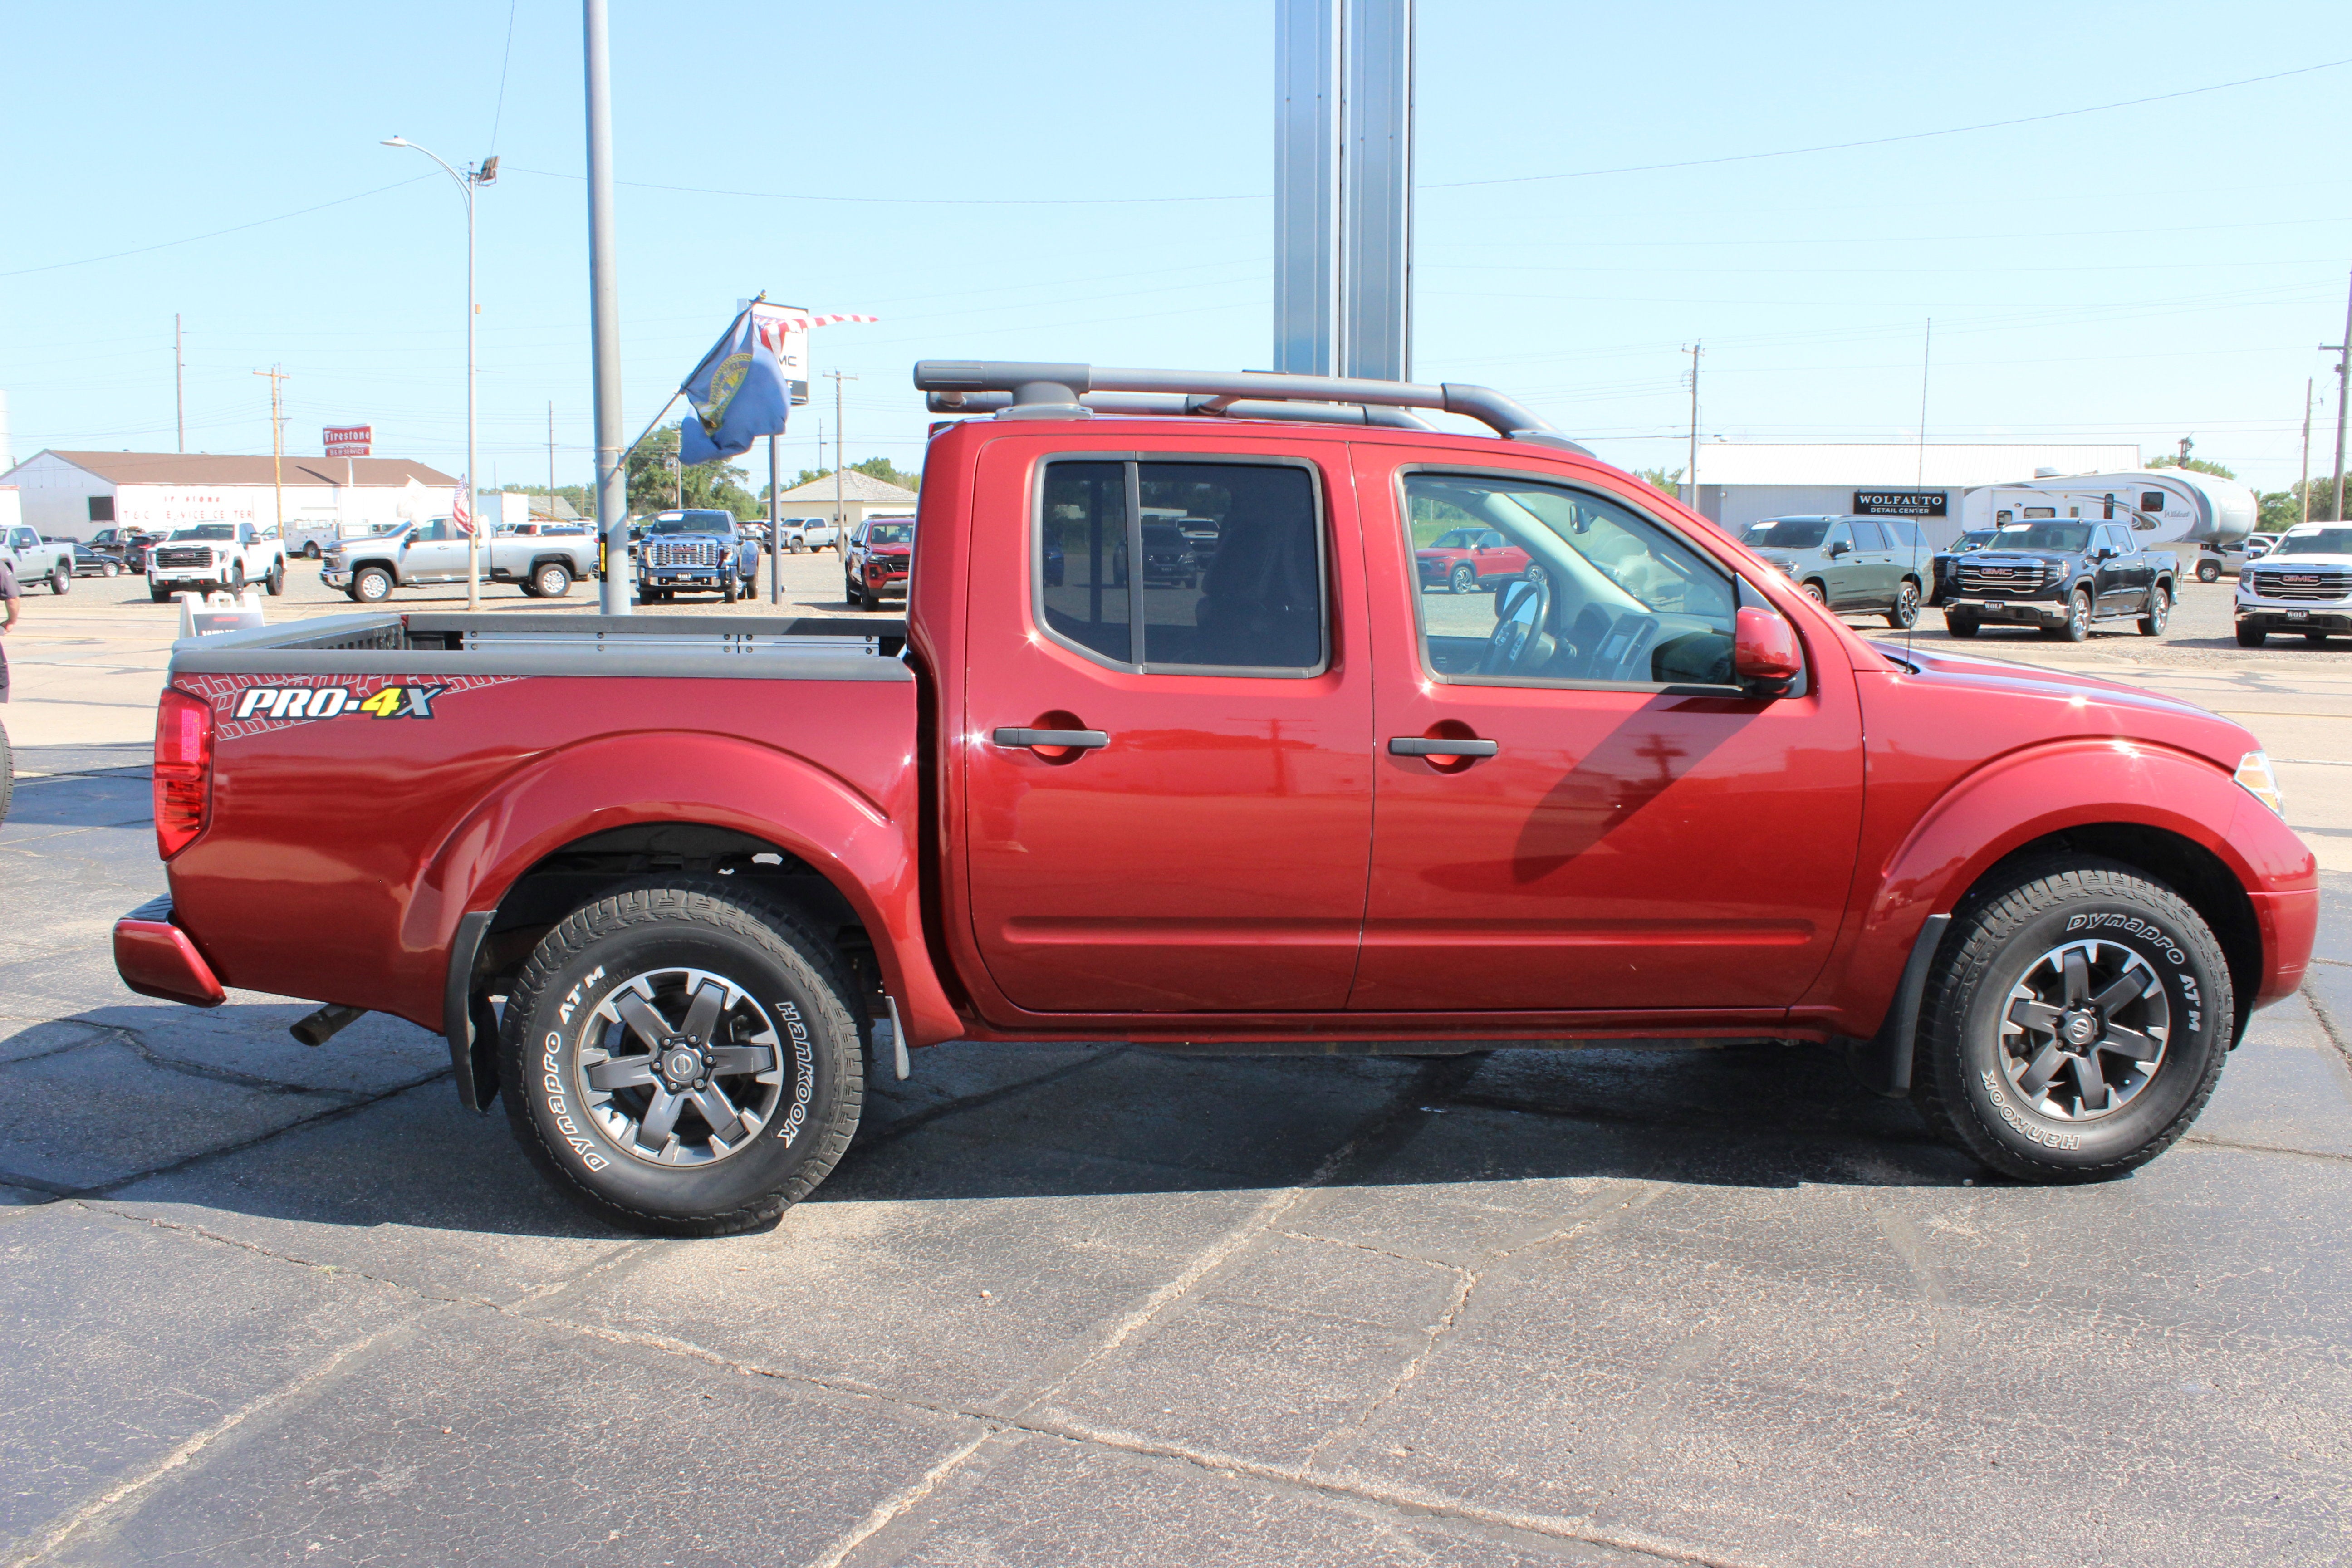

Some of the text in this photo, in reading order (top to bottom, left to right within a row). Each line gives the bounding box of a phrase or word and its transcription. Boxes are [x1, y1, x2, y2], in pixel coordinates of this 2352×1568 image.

[779, 355, 797, 367] MC
[324, 430, 370, 443] Firestone
[1859, 495, 1942, 505] WOLFAUTO
[214, 510, 252, 519] CETER
[235, 687, 444, 718] PRO-4X
[2066, 913, 2186, 965] Dynapro
[543, 1031, 610, 1172] Dynapro
